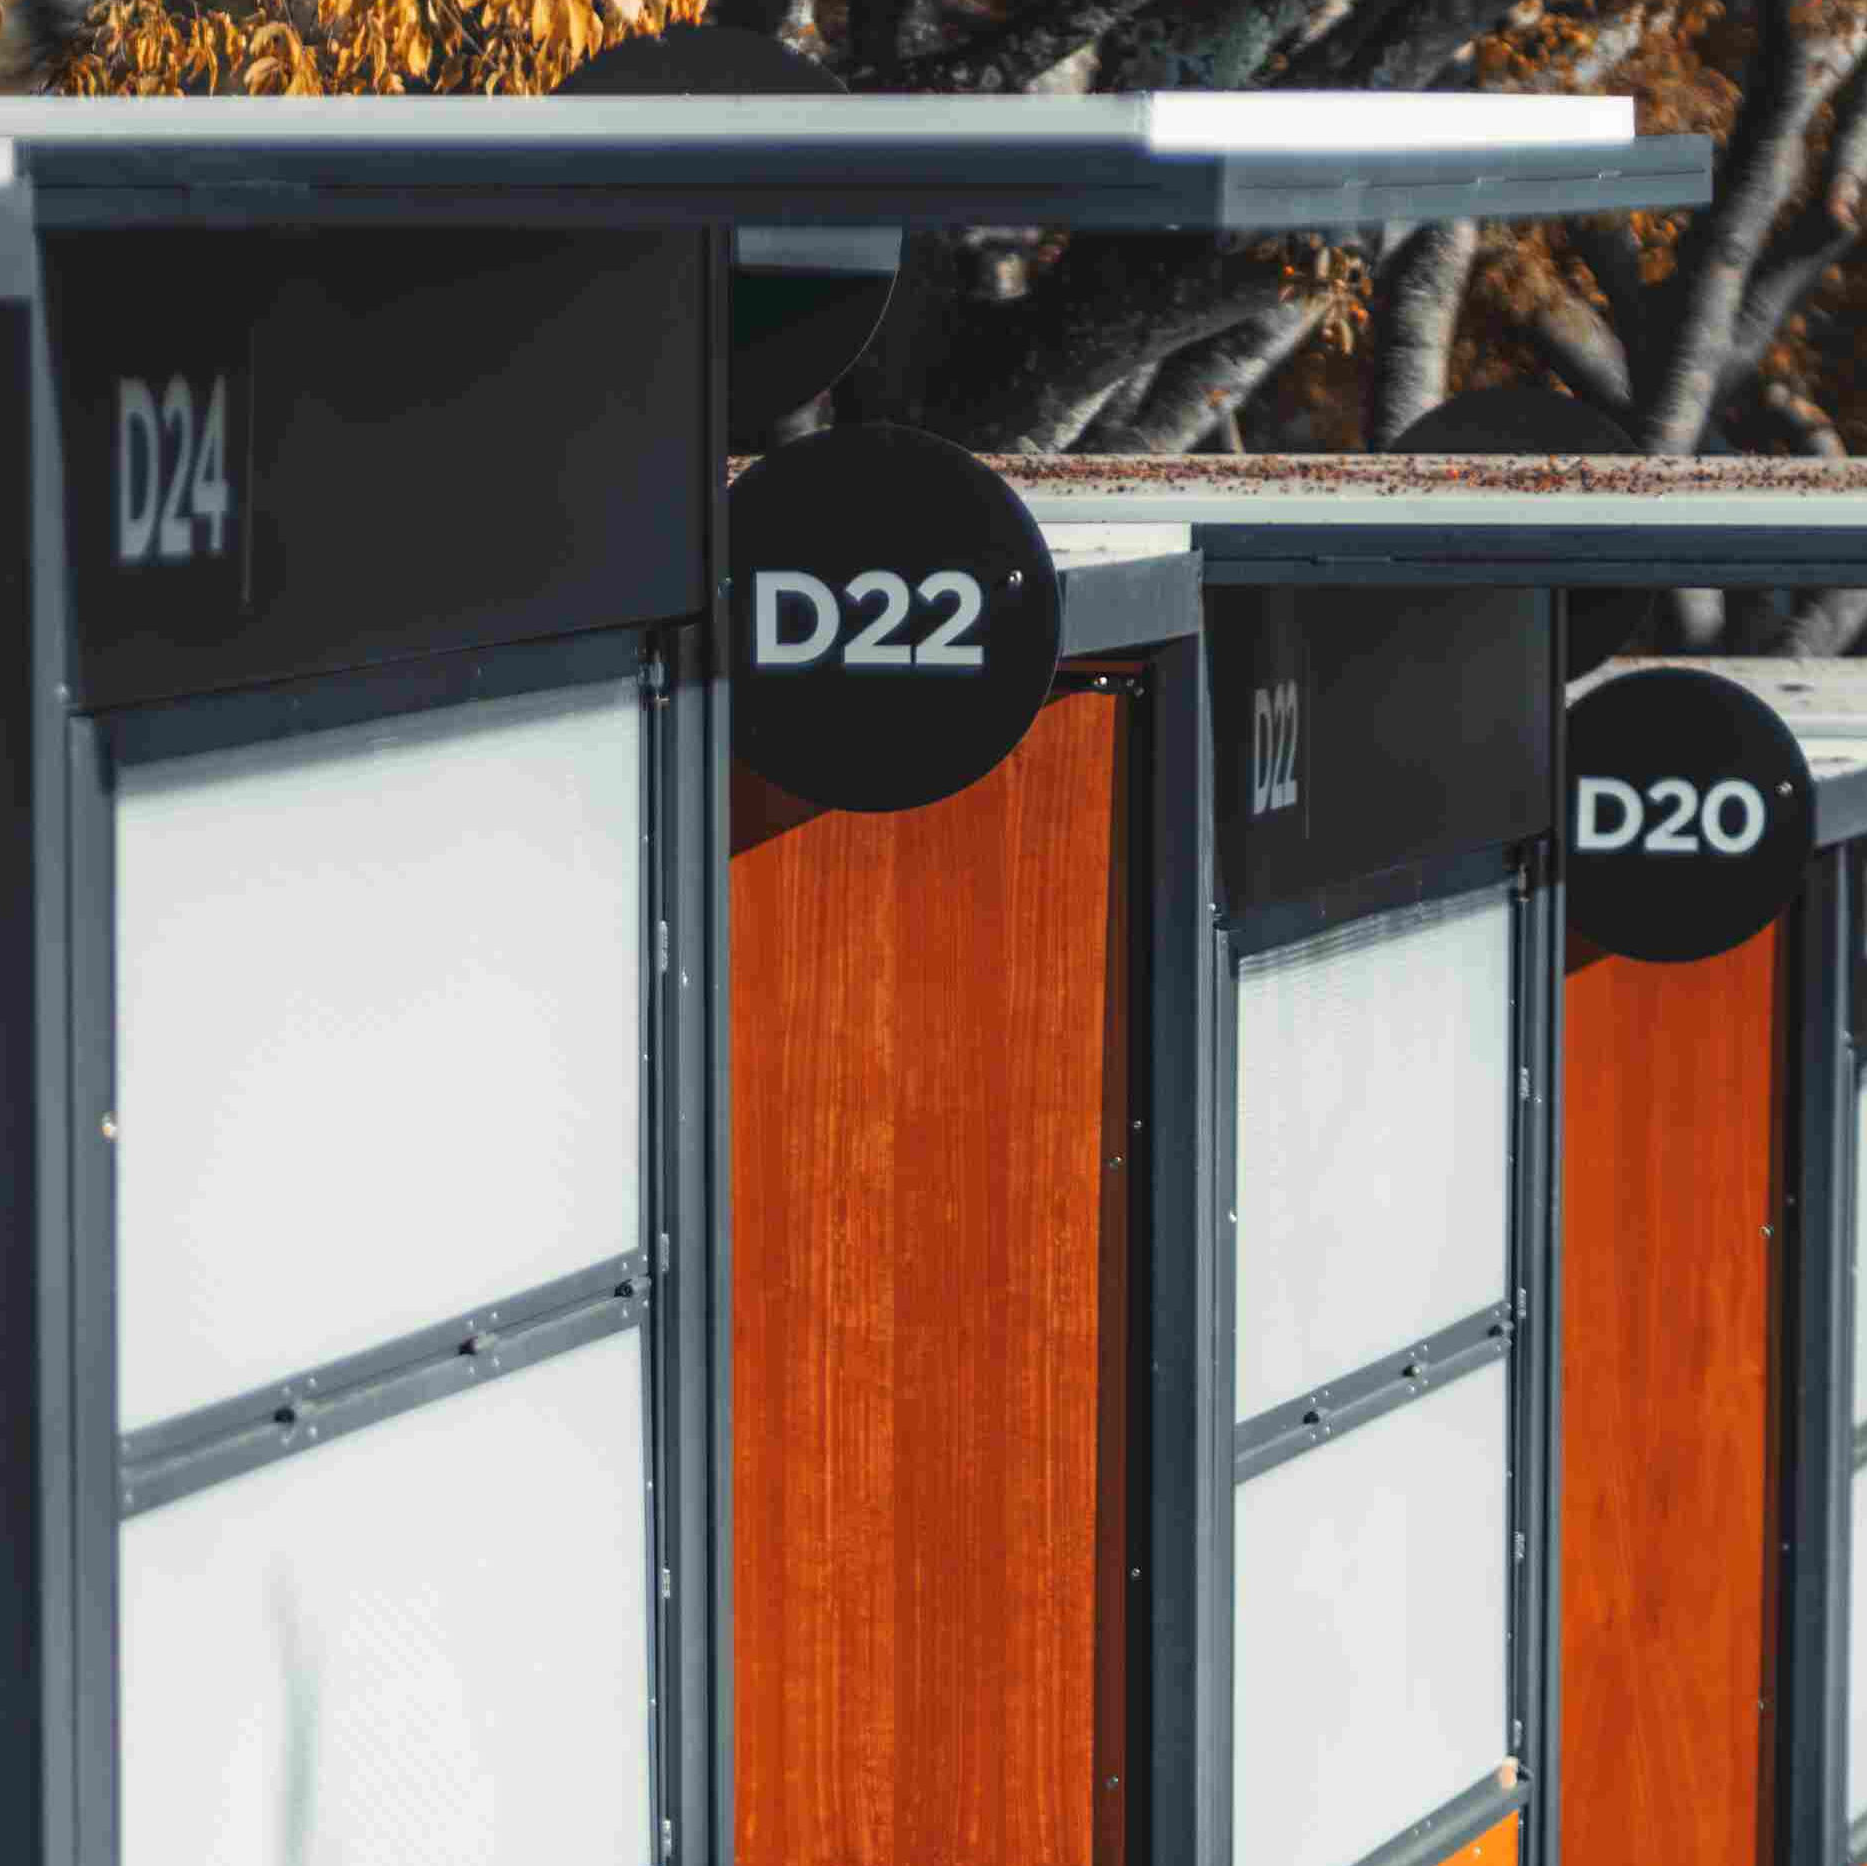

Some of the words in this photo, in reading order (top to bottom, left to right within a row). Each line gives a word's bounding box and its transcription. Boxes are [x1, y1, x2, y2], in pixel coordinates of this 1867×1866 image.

[119, 375, 228, 560] D24
[755, 570, 983, 666] D22
[1254, 680, 1297, 815] D22
[1577, 778, 1765, 854] D20
